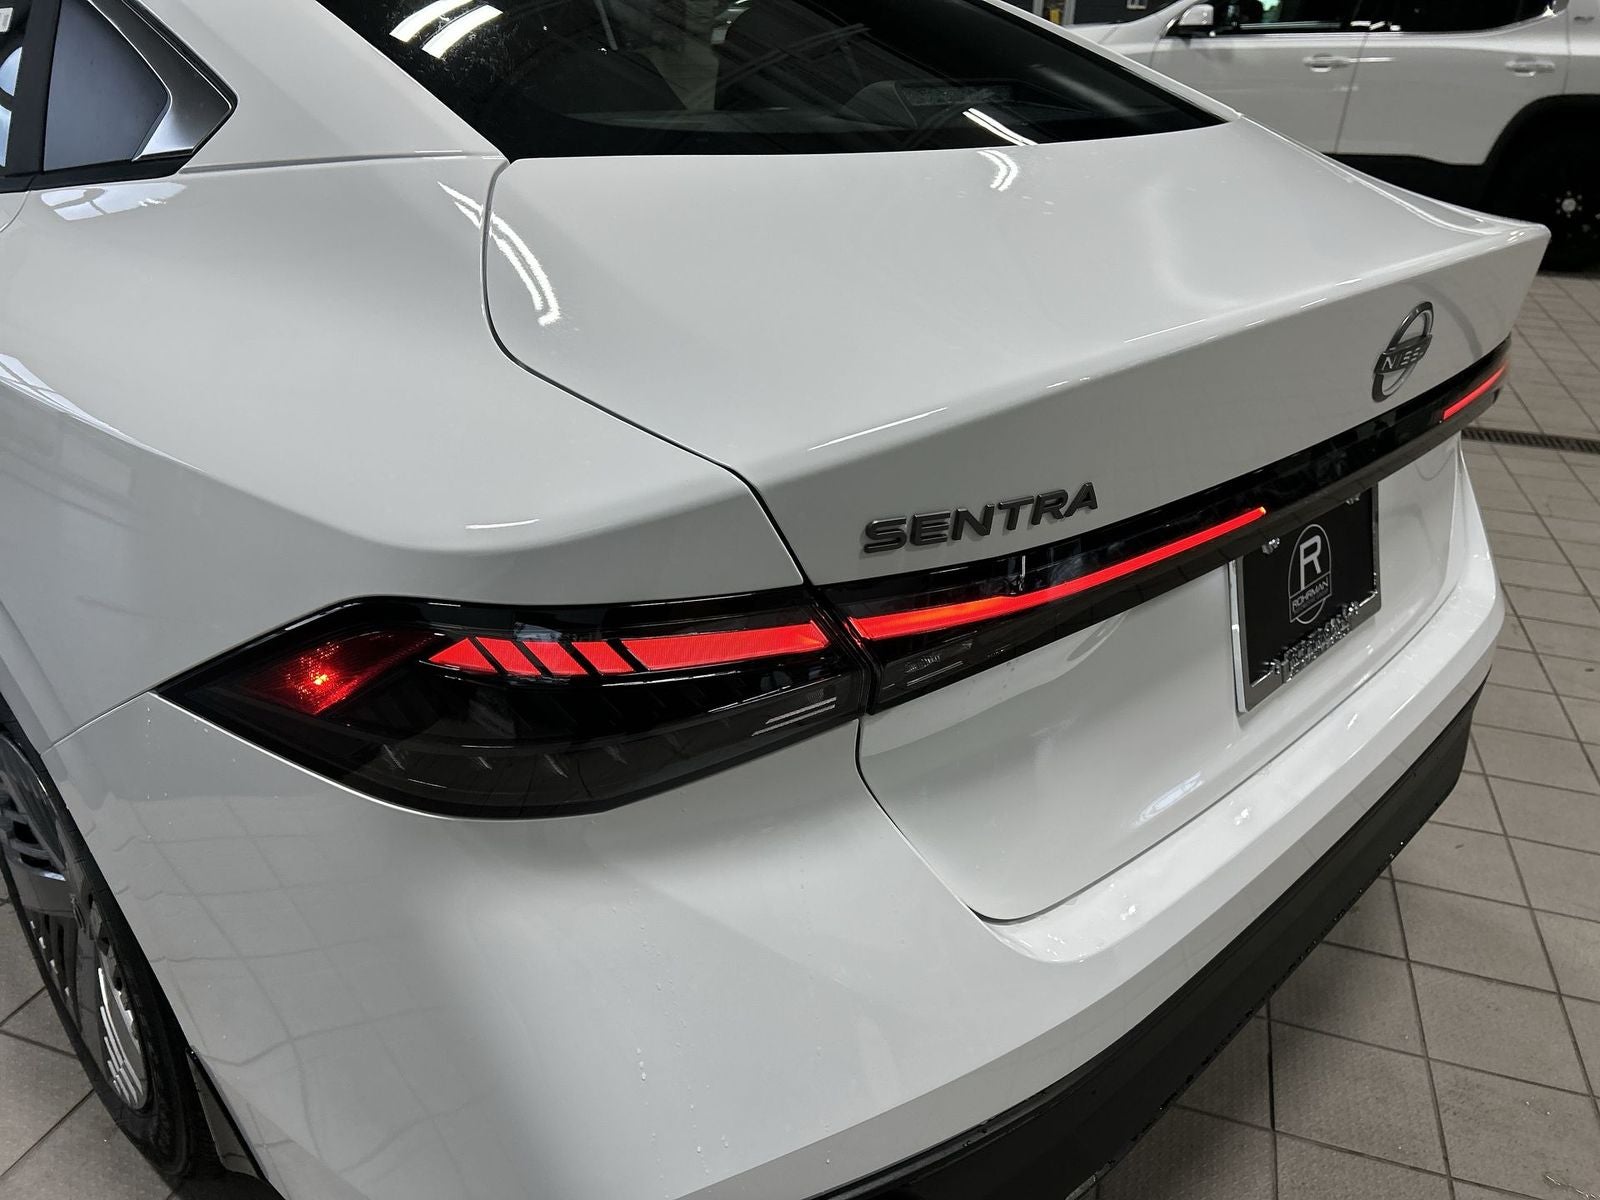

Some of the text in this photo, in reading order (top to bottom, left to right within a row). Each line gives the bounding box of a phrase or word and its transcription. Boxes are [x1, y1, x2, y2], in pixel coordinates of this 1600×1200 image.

[1381, 345, 1426, 371] NISS
[863, 482, 1098, 554] SENTRA
[1300, 535, 1322, 591] R
